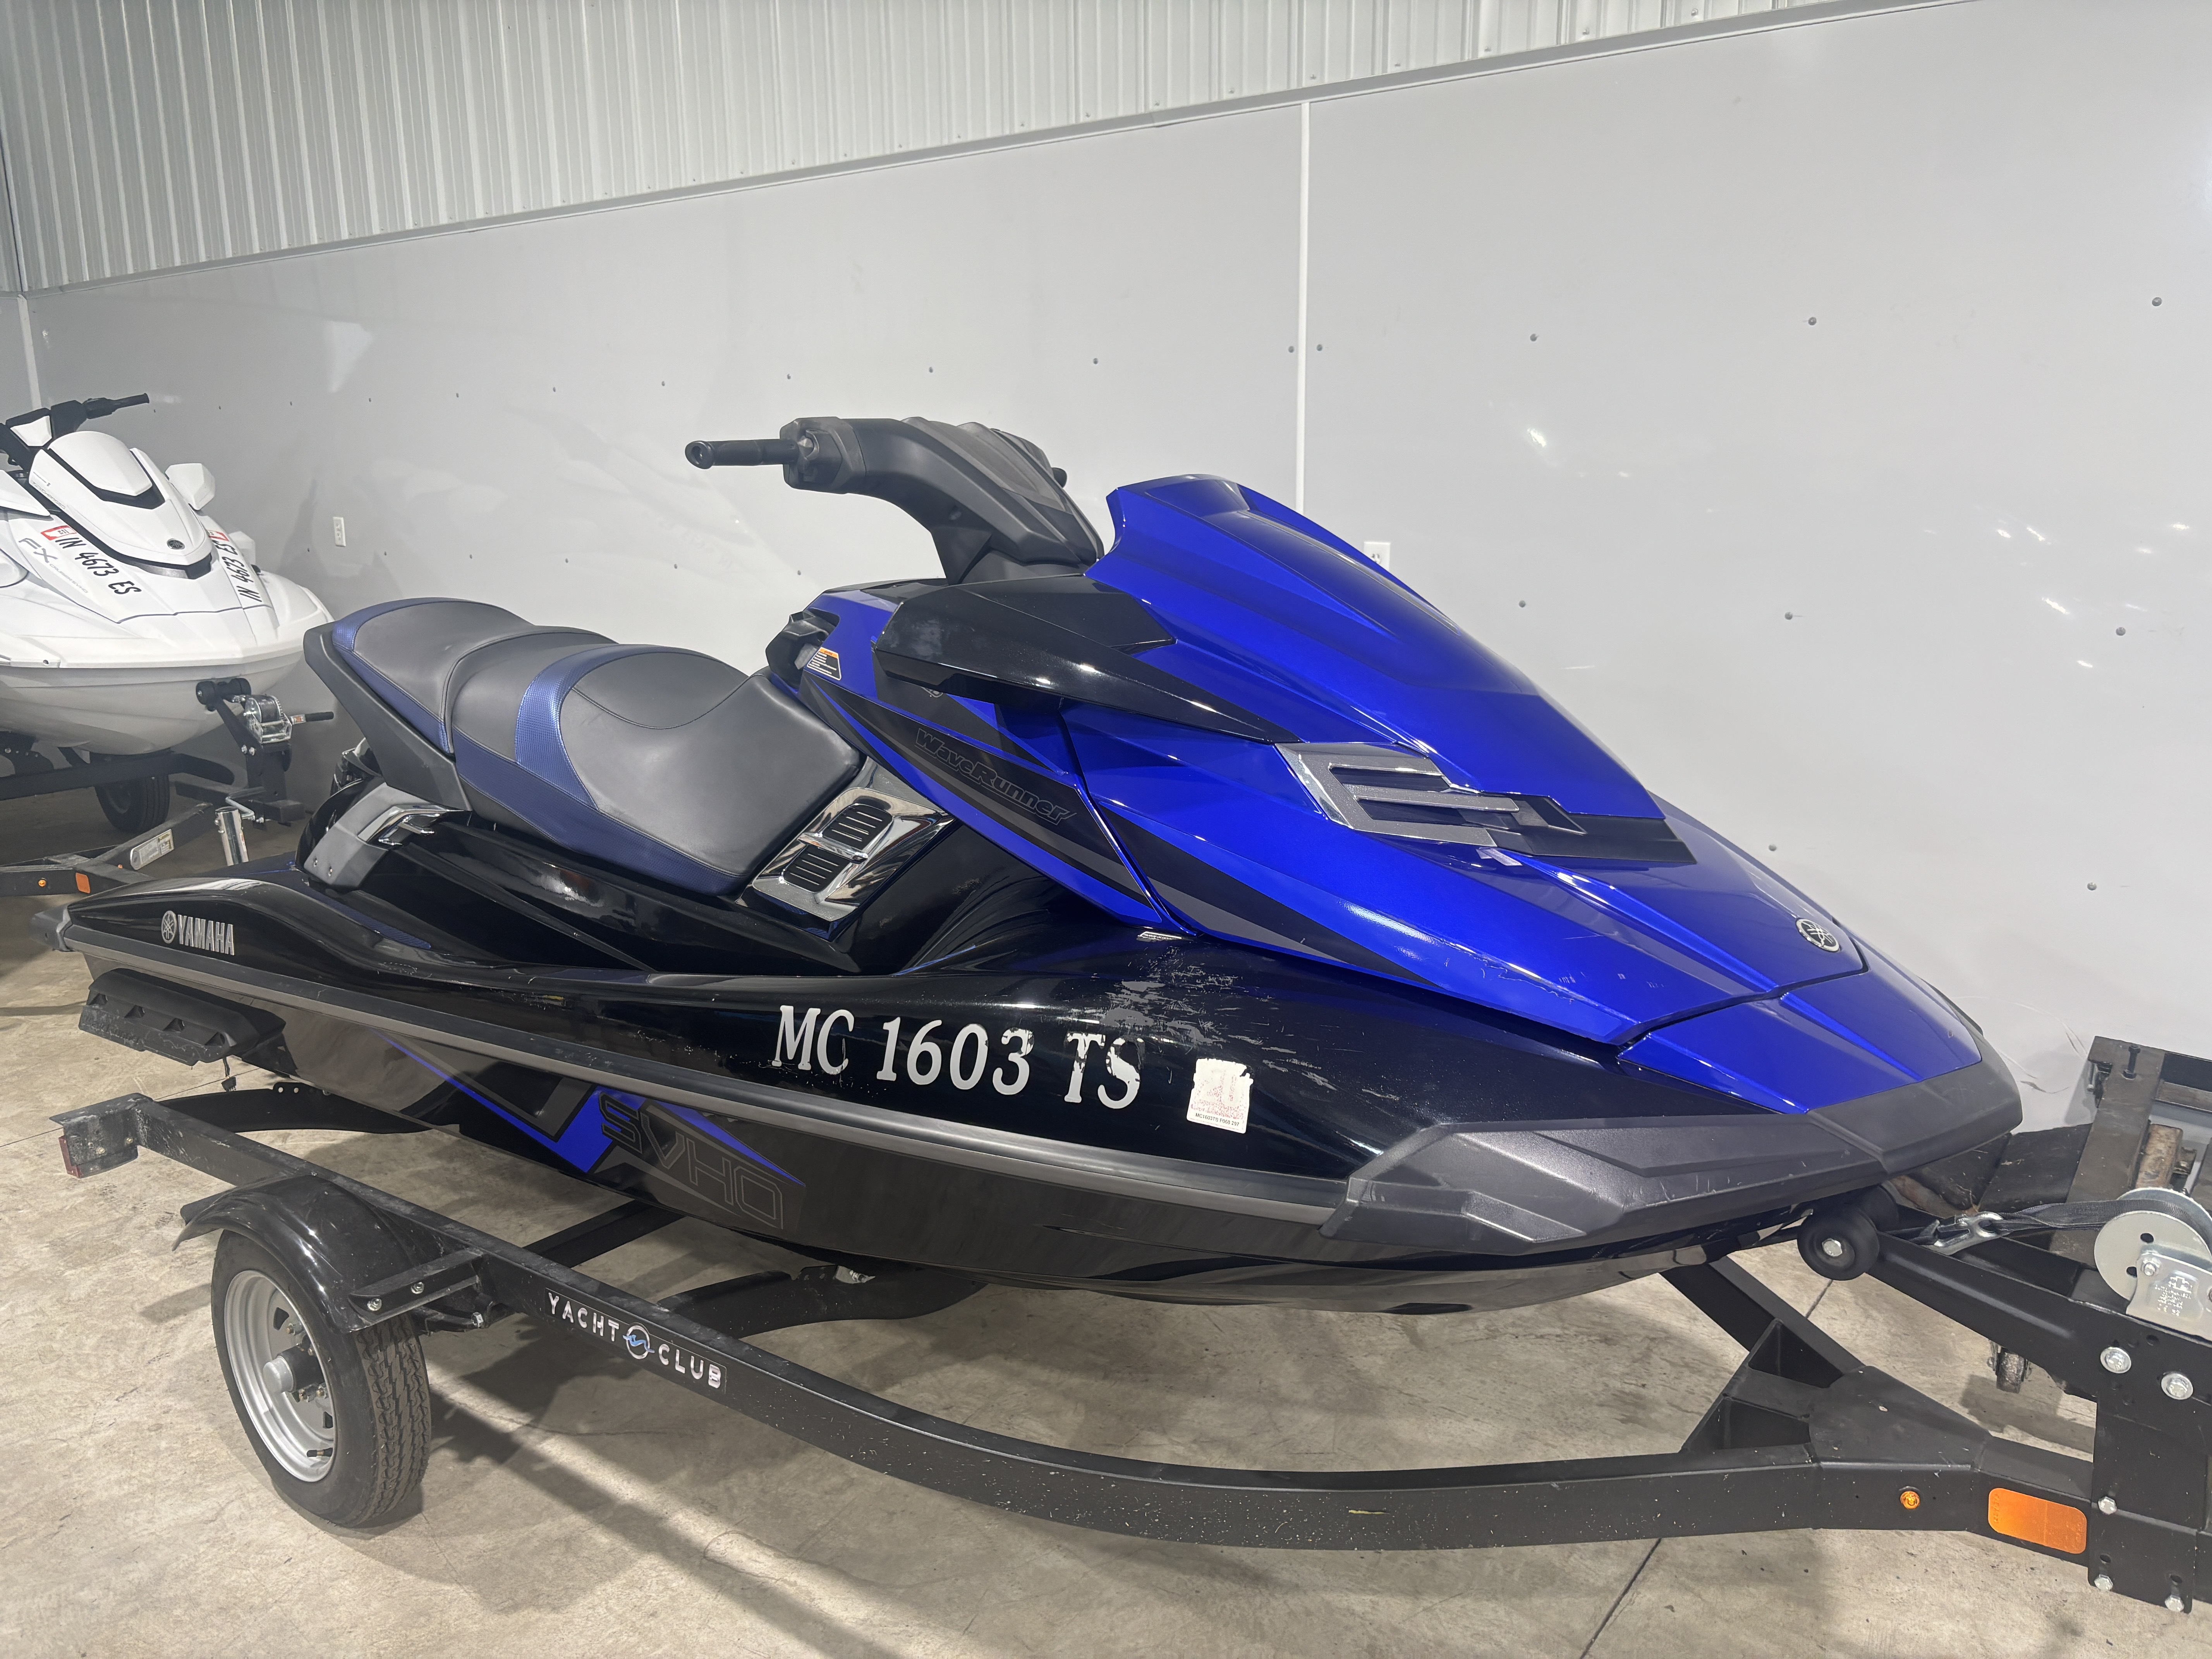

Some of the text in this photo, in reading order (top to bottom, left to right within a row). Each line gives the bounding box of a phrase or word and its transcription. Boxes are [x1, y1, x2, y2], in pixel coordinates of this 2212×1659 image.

[19, 538, 58, 563] FX
[55, 537, 142, 594] IN 4673 ES
[211, 539, 263, 602] IN 4673 ES
[914, 728, 1073, 823] WaveRunner
[177, 914, 235, 955] YAMAHA
[771, 1005, 1145, 1109] MC 1603 TS
[599, 1092, 783, 1229] SVHO
[548, 1292, 722, 1389] YACHT CLUB
